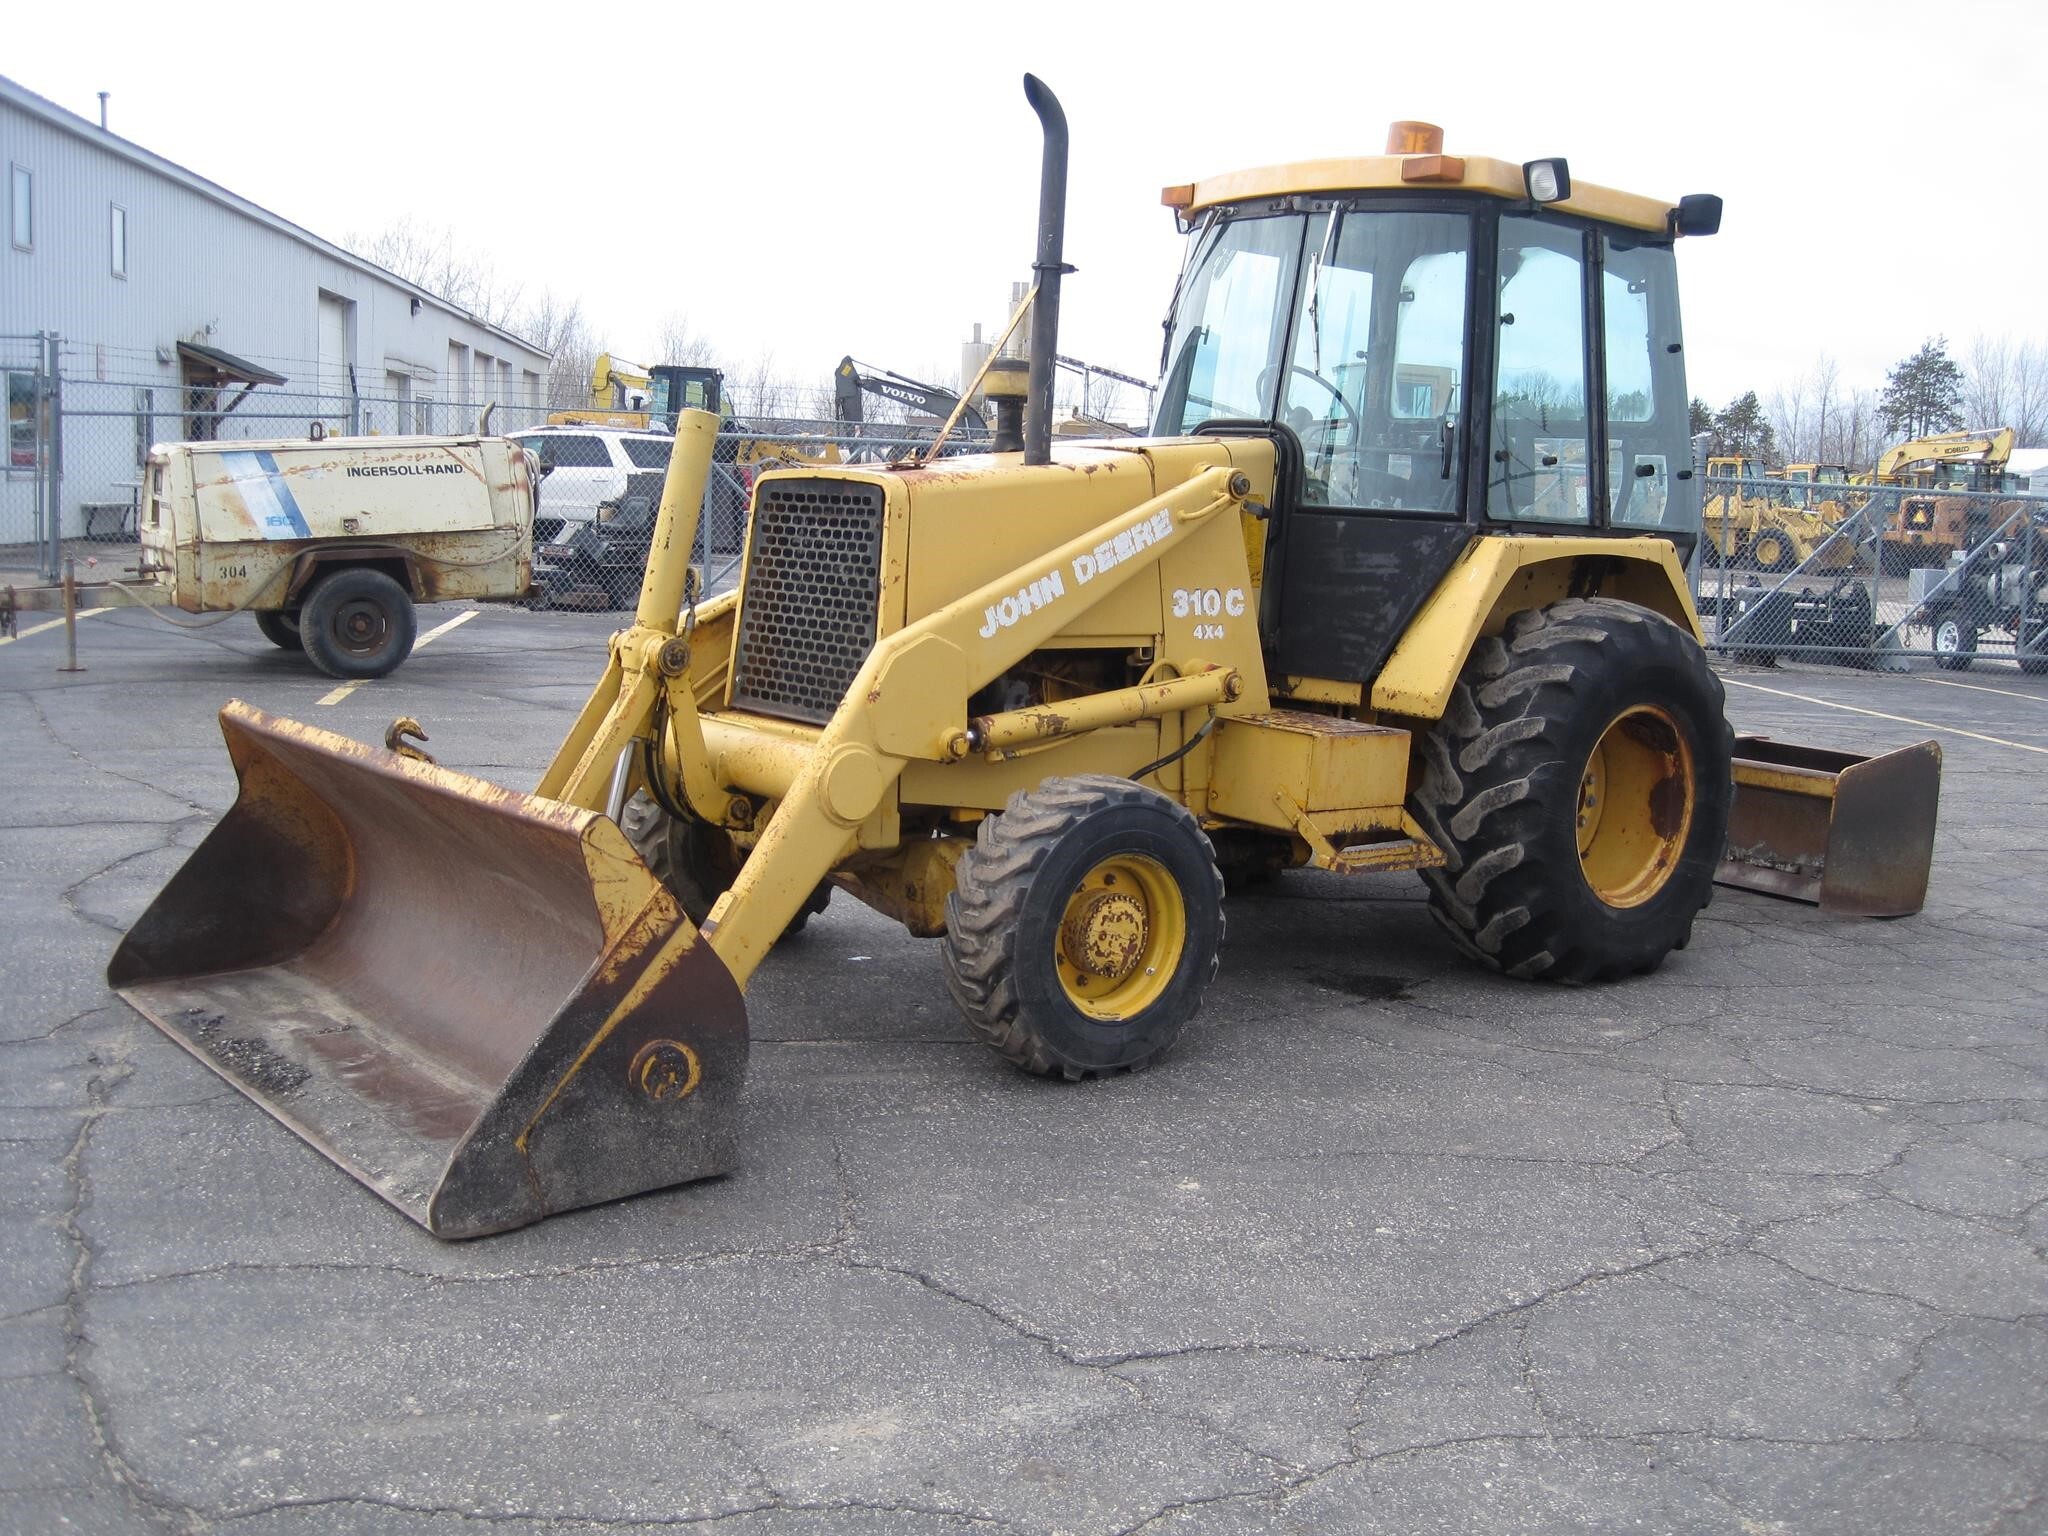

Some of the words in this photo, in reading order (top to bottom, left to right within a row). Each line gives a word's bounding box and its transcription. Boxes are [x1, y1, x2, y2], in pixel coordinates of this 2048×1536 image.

[881, 385, 926, 405] VOLVO
[347, 464, 464, 477] INGERSOLL-RAND
[219, 565, 247, 579] 304
[979, 570, 1065, 638] JOHN
[1072, 508, 1173, 585] DEERE
